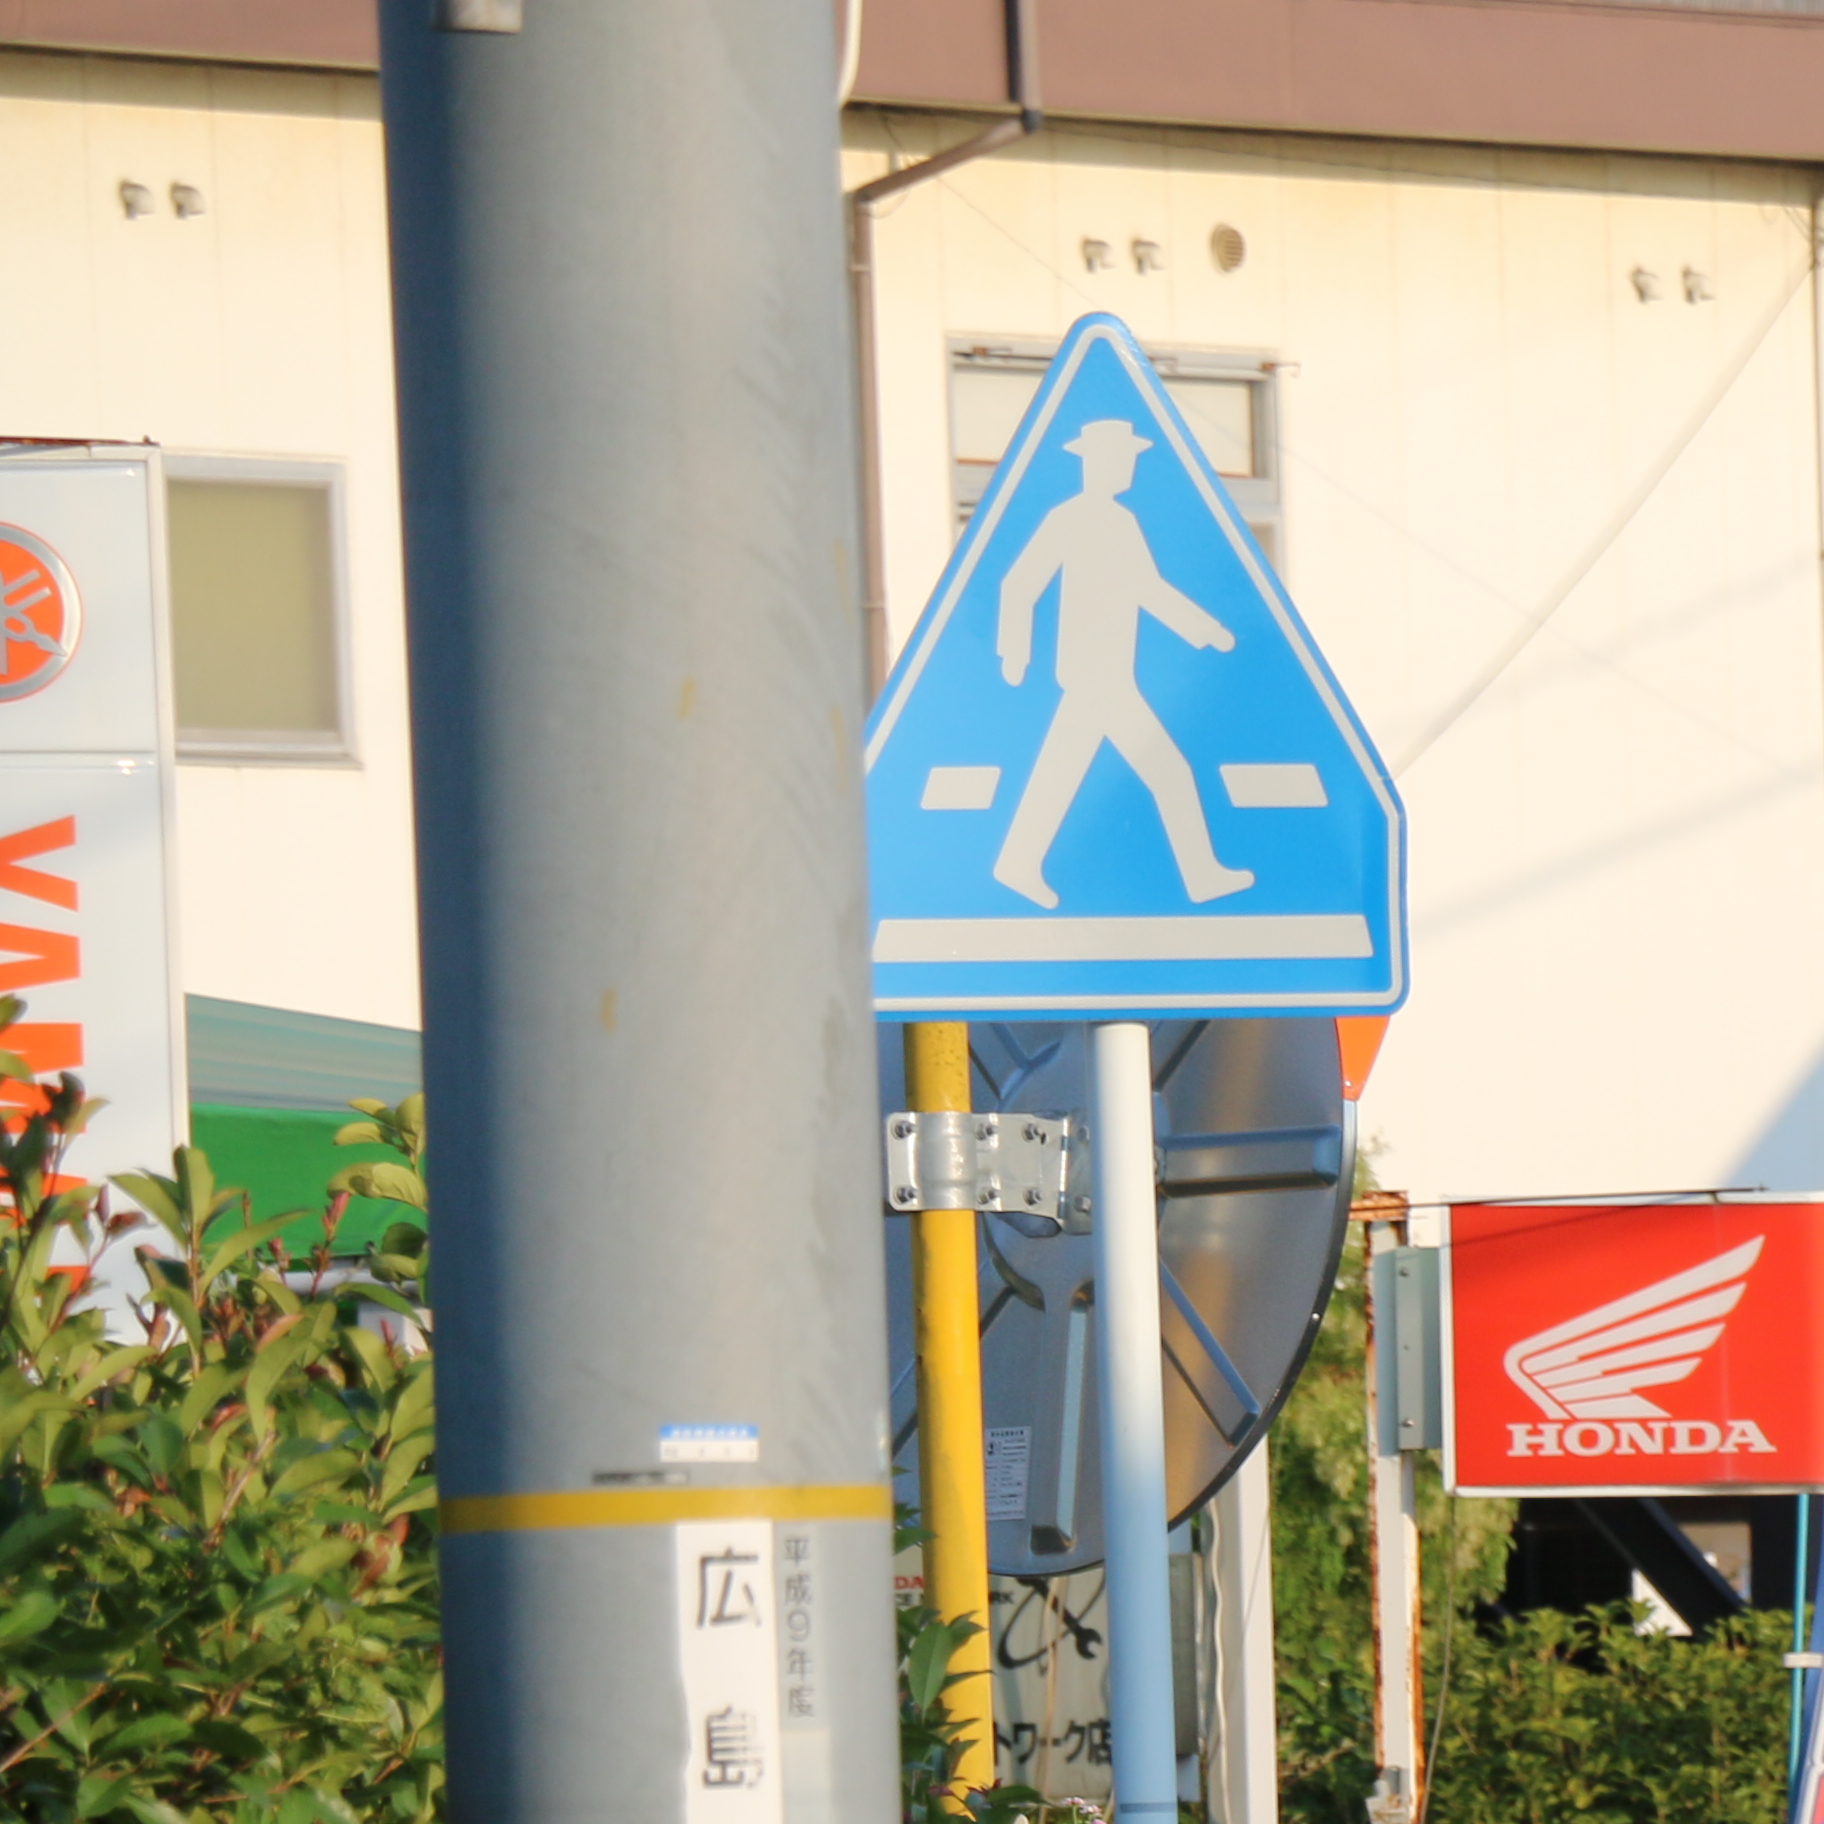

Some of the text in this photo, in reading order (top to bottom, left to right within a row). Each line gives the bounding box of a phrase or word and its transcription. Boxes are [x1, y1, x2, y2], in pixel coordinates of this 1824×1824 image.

[1506, 1419, 1777, 1457] HONDA
[783, 1535, 817, 1719] 平成9年度
